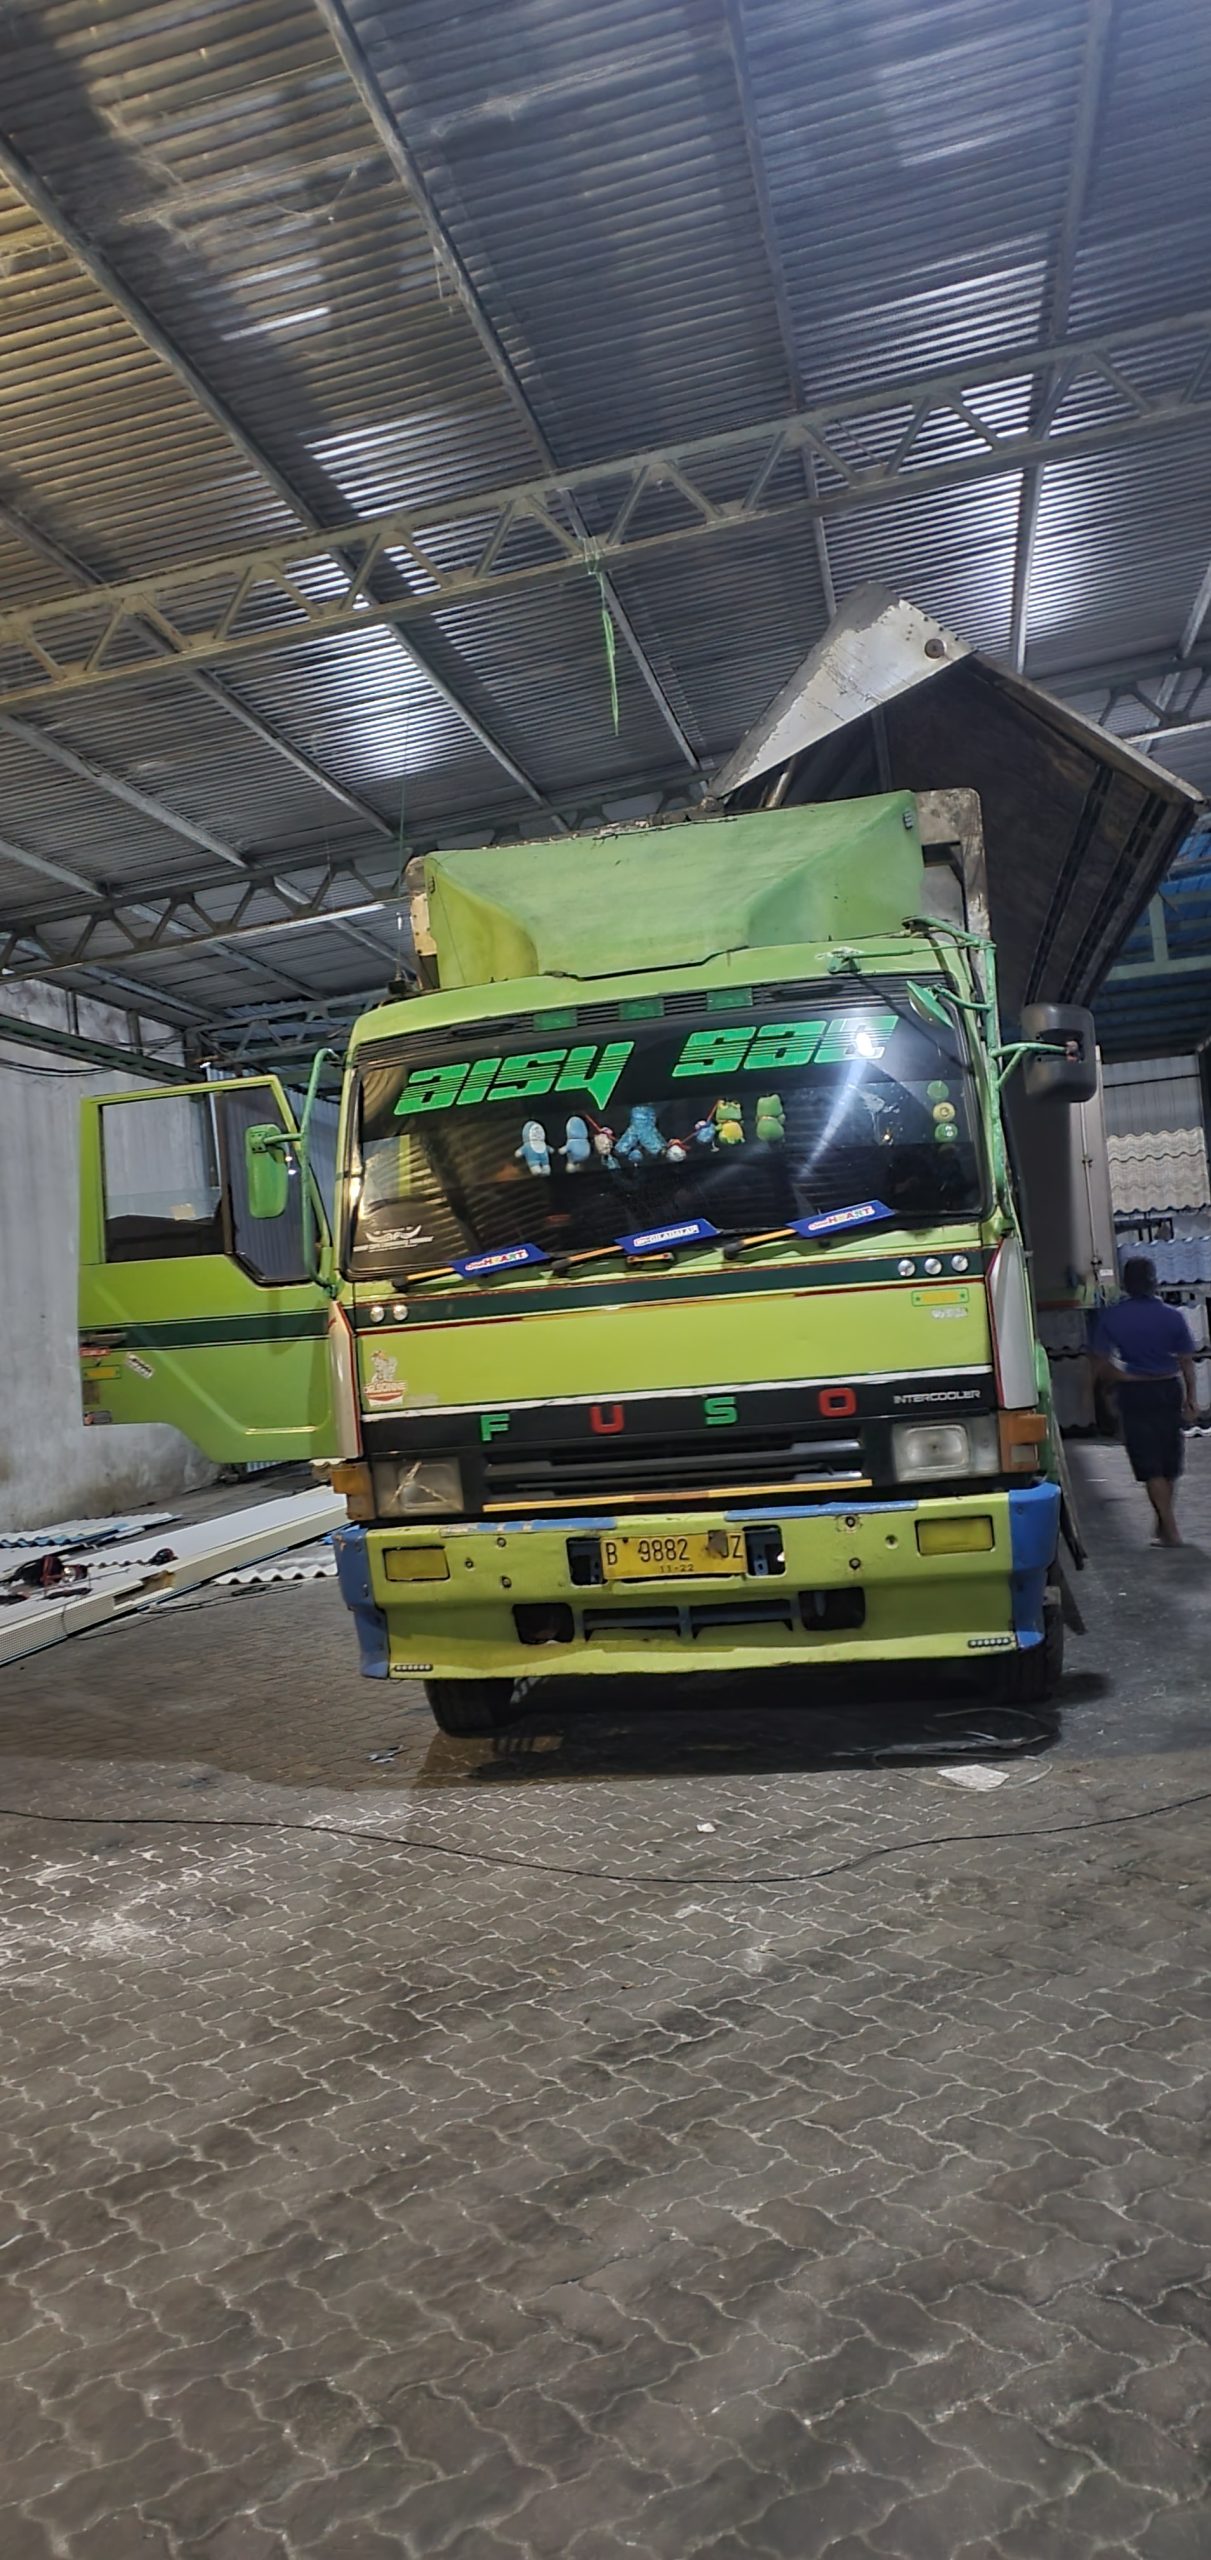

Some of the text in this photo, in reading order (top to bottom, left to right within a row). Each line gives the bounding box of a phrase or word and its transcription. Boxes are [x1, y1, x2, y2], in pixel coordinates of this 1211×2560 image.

[893, 1390, 980, 1404] INTERCOOLER
[480, 1387, 857, 1442] FUSO
[605, 1541, 618, 1565] B
[637, 1538, 690, 1563] 9882
